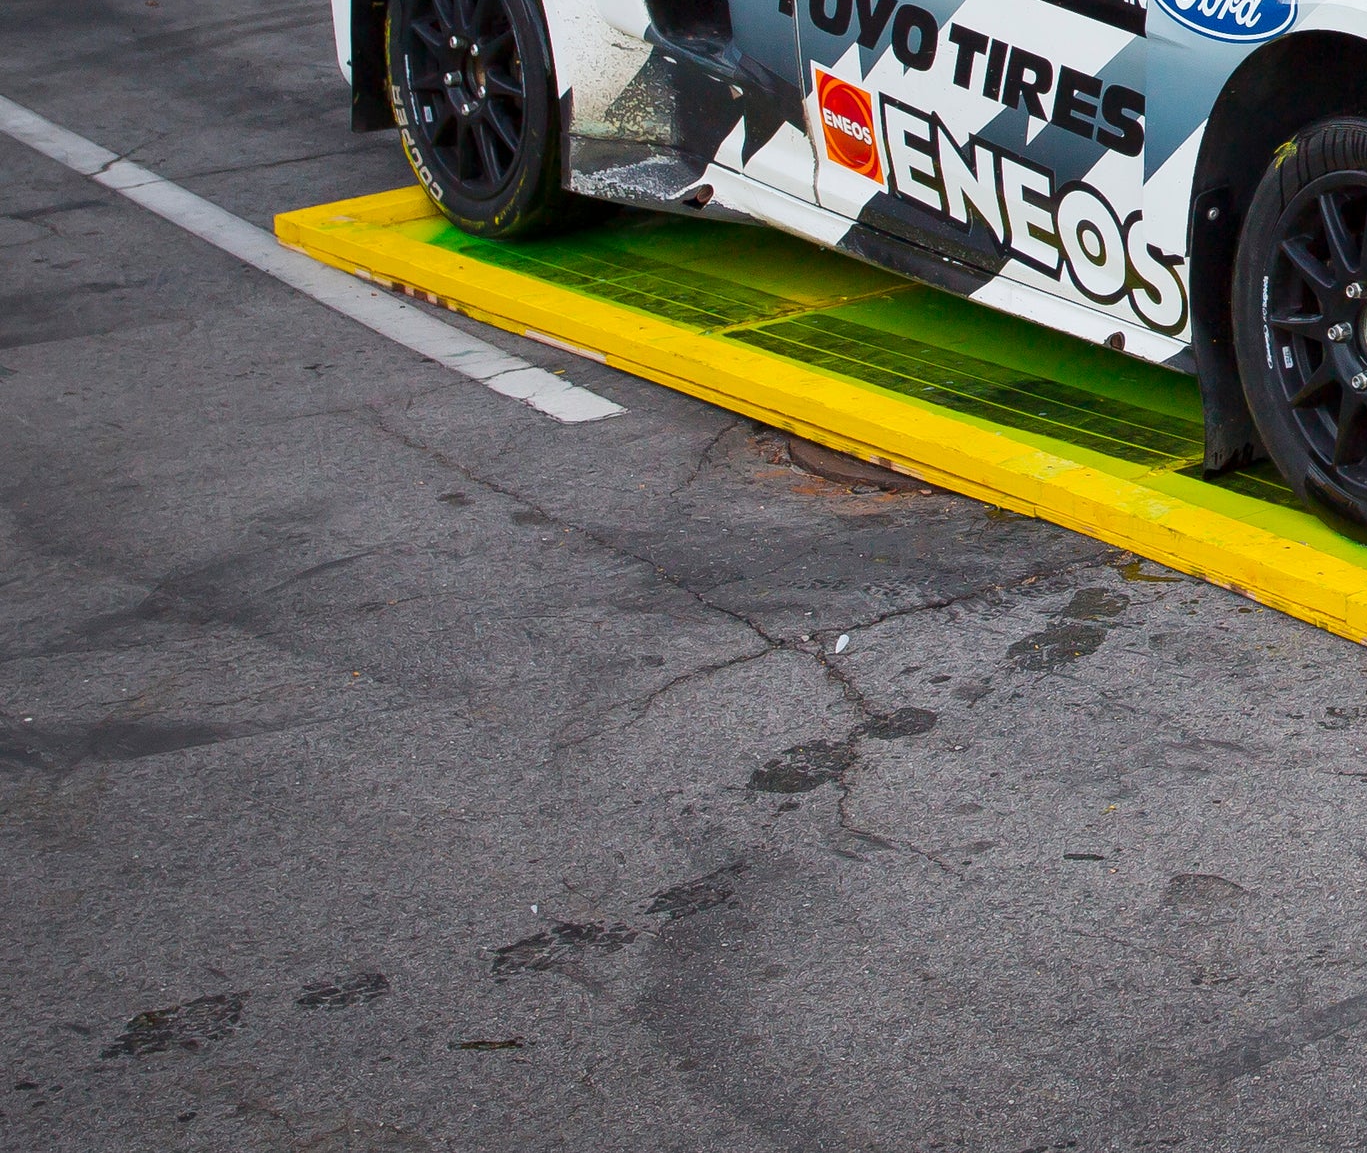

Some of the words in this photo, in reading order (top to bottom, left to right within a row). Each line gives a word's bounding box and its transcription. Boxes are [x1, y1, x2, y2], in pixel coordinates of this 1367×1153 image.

[822, 107, 873, 145] ENEOS
[948, 22, 1146, 158] TIRES
[878, 92, 1189, 337] ENEOS
